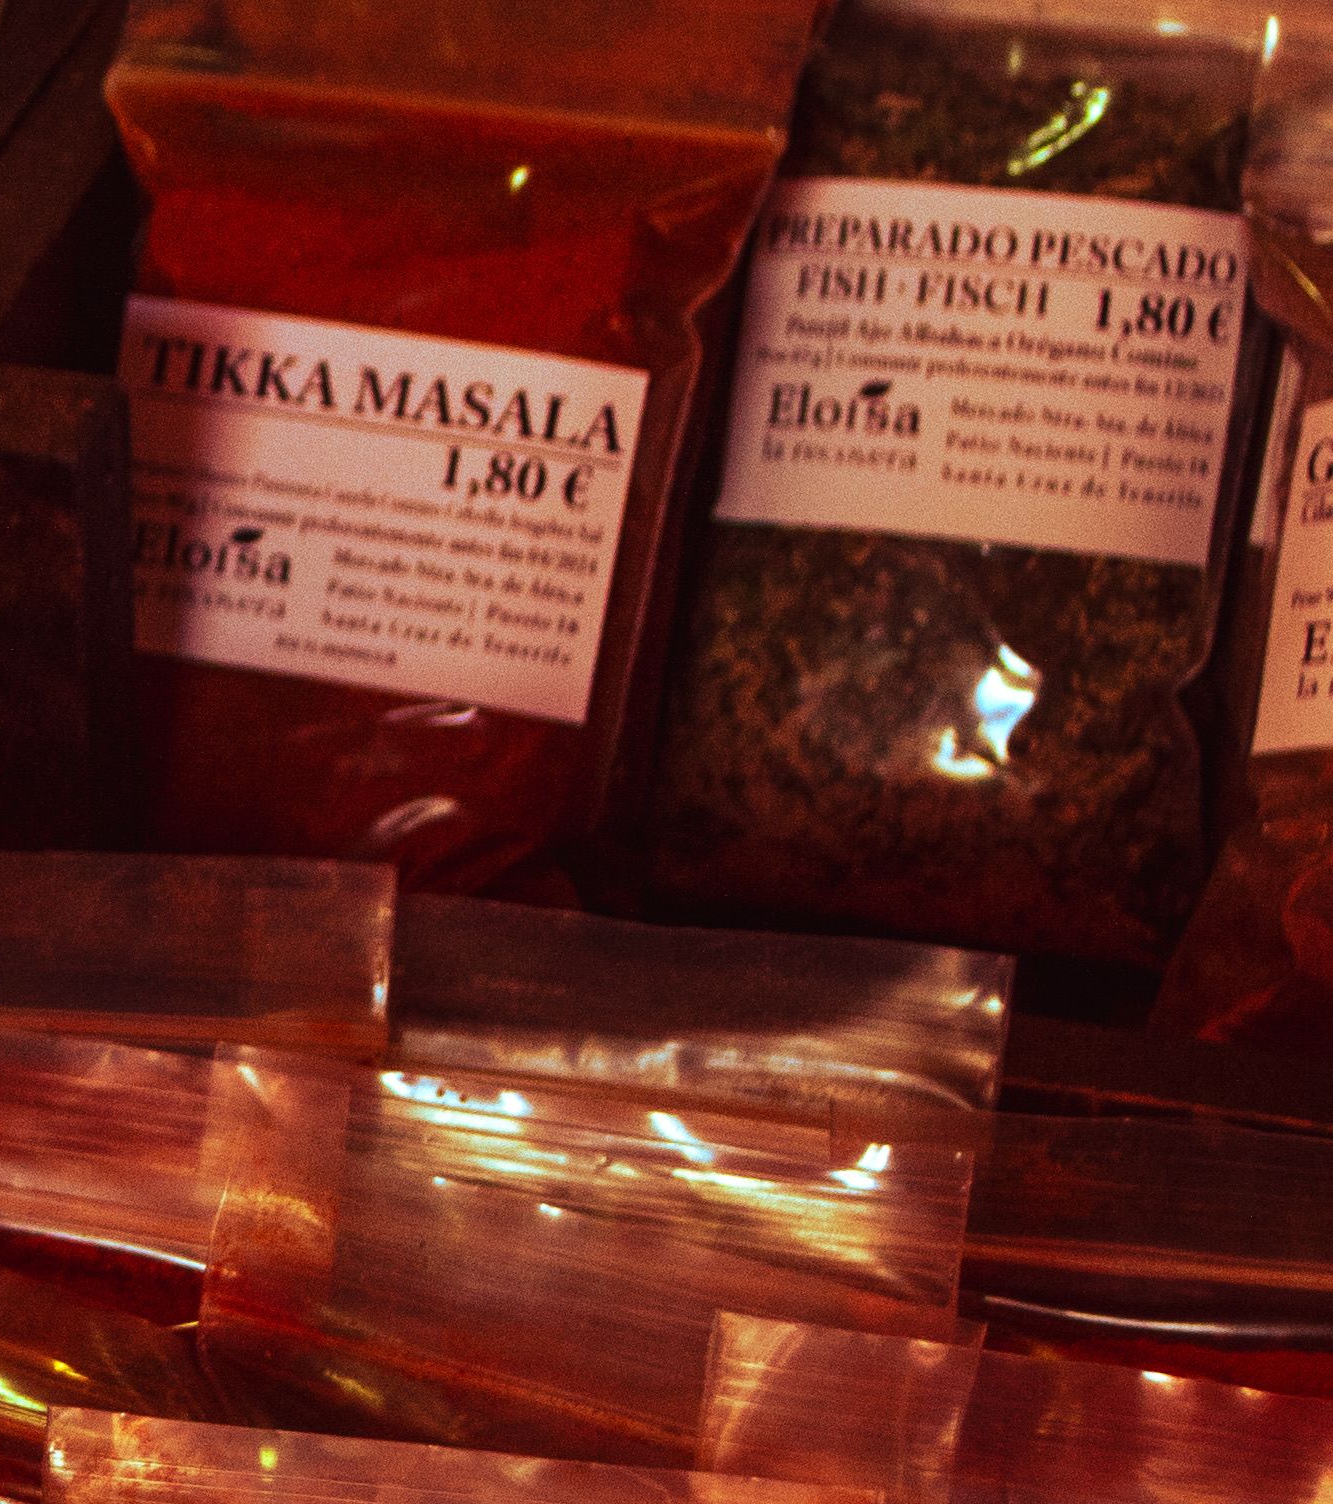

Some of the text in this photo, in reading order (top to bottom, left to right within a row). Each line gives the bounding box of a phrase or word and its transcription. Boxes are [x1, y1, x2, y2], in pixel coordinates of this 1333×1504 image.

[767, 213, 1237, 284] PREPARADO PESCADO
[797, 263, 887, 304] FISH
[916, 271, 1051, 320] FISCH
[1095, 286, 1196, 341] 1,80
[143, 333, 623, 451] TIKKA MASALA
[440, 443, 549, 504] 1,80
